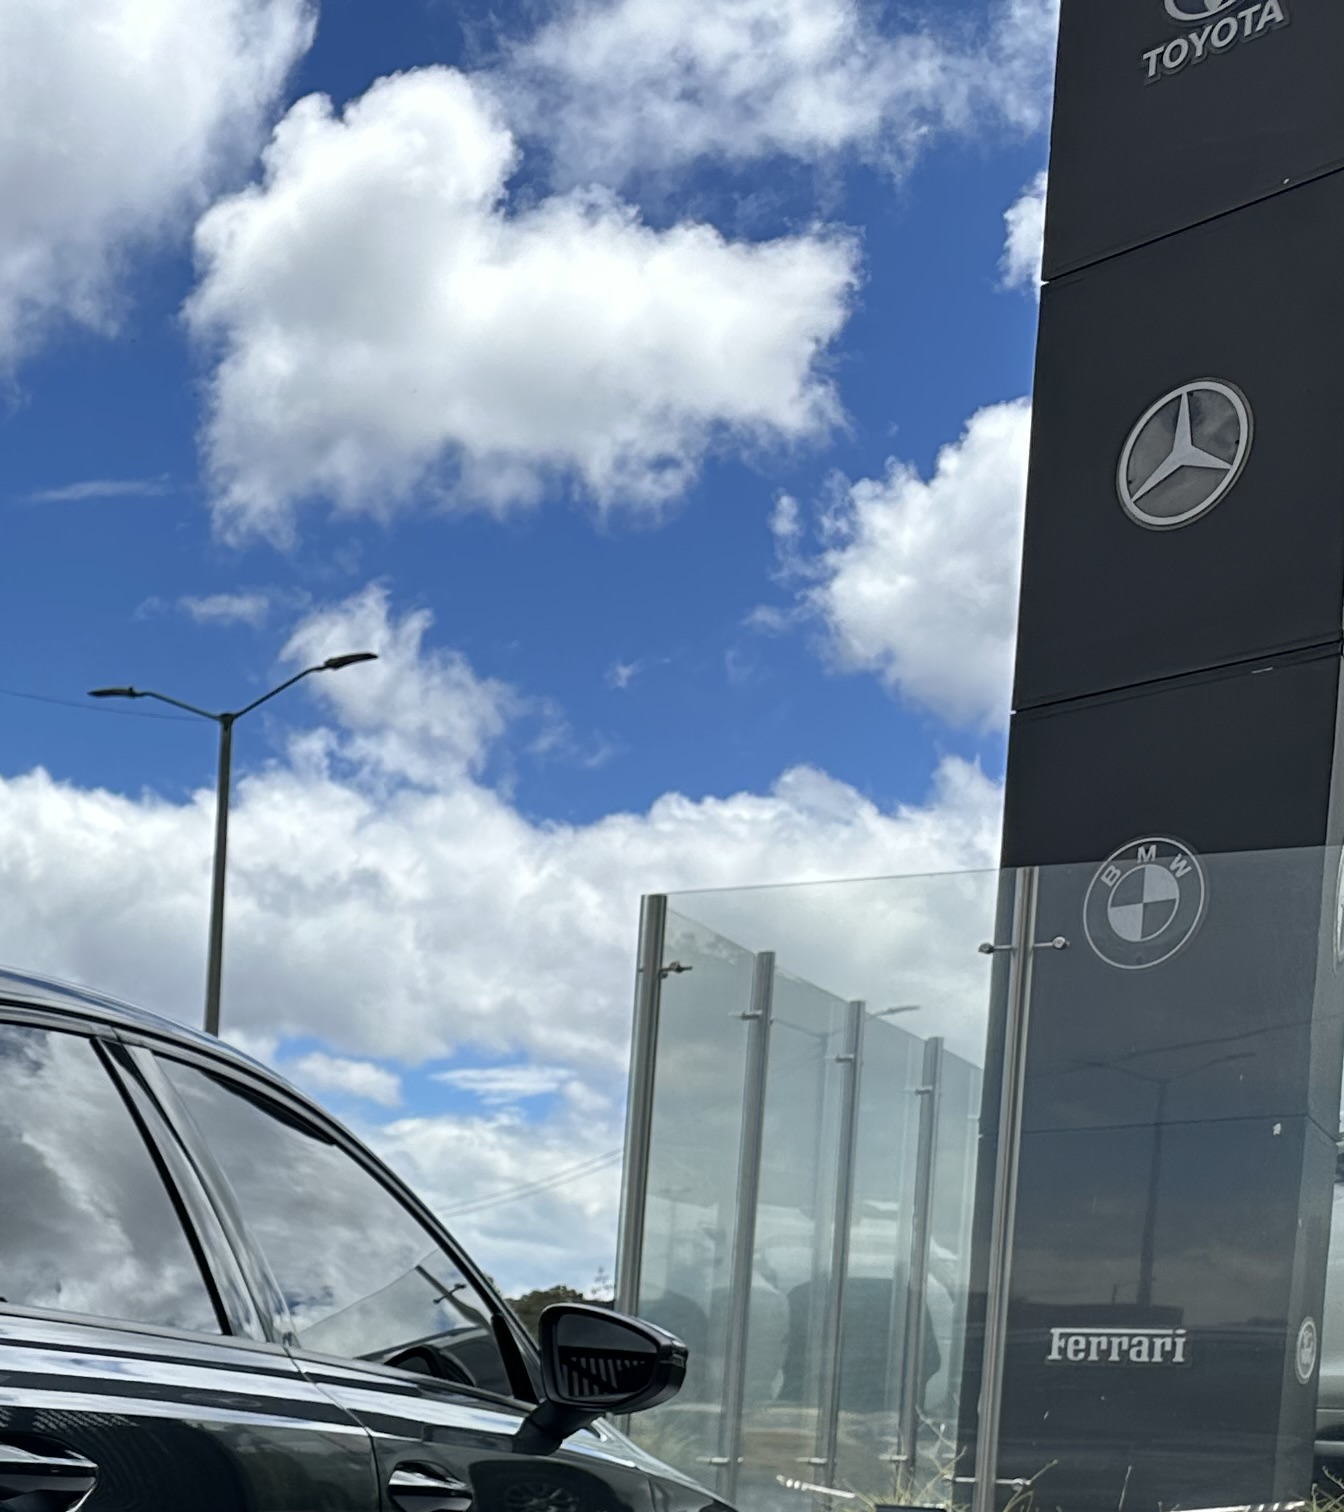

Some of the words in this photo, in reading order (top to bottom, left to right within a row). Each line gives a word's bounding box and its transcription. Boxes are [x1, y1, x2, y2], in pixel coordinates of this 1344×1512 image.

[1142, 0, 1285, 78] TOYOTA
[1100, 844, 1192, 887] BMW
[1046, 1327, 1188, 1363] Ferrari
